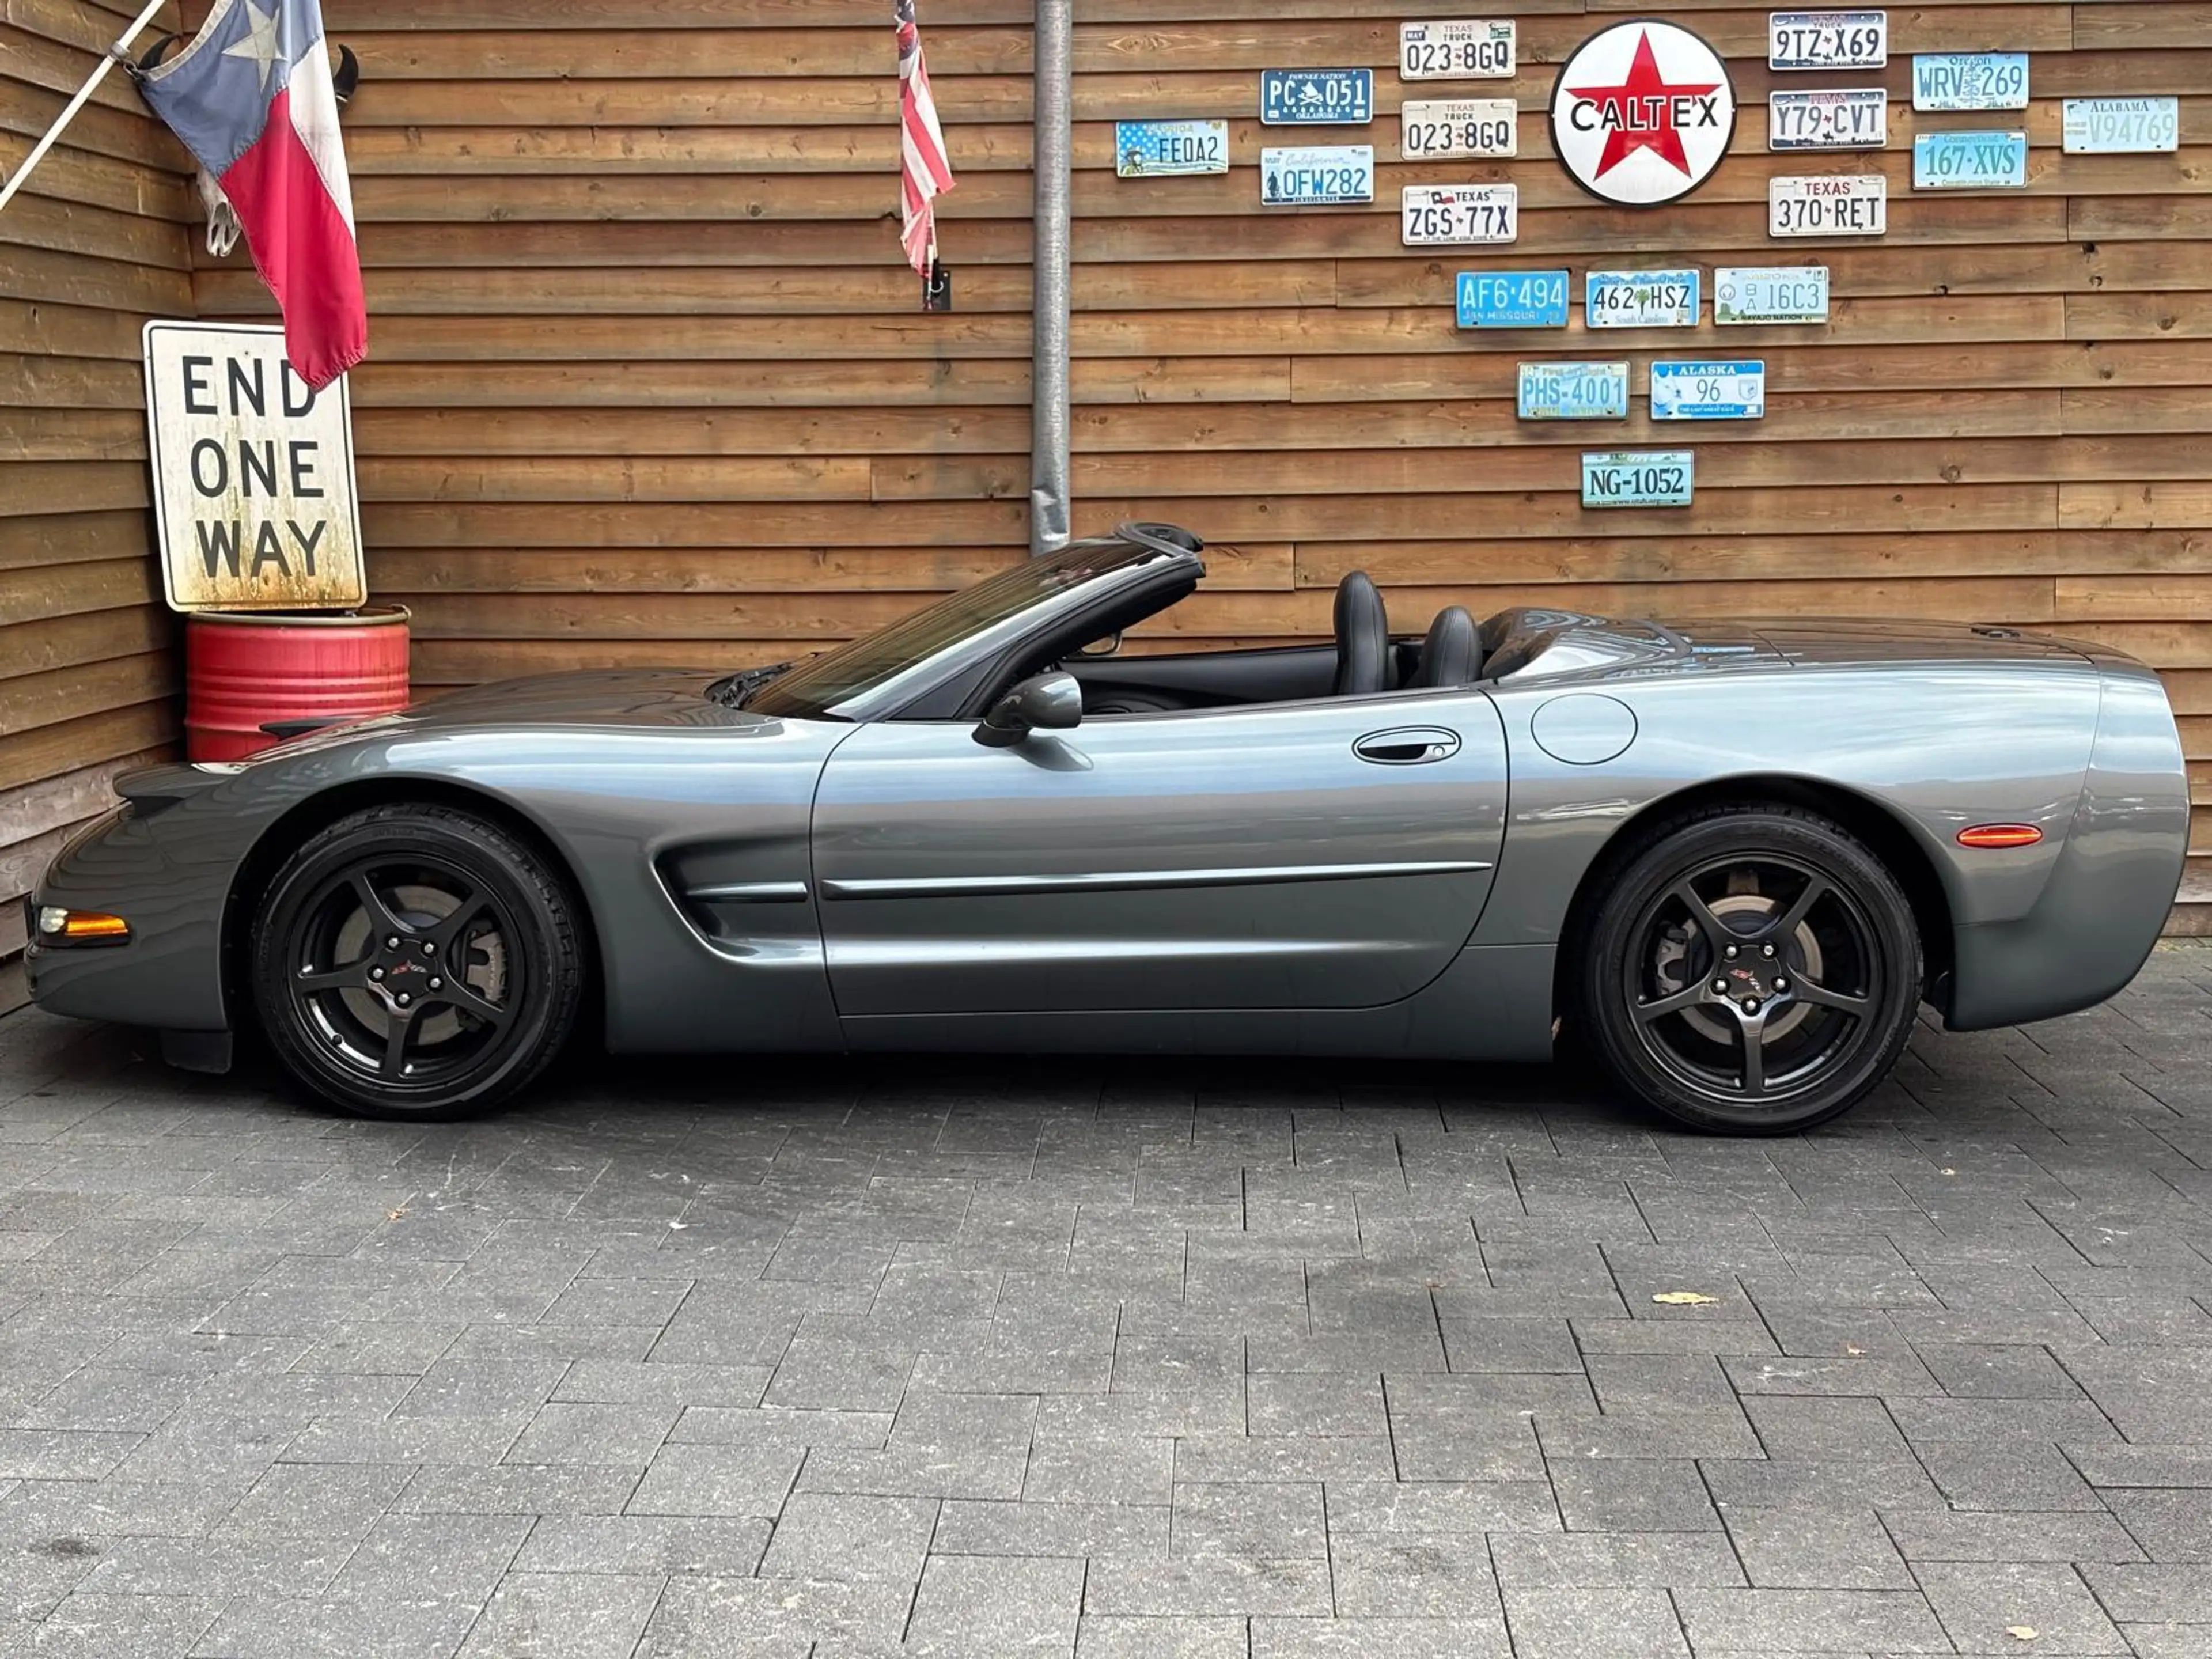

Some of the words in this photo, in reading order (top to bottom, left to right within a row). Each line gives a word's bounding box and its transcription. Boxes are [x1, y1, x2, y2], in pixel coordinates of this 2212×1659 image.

[1949, 56, 1991, 66] Oregon
[1571, 97, 1718, 131] CALTEX
[2090, 101, 2149, 113] ALABAMA
[2089, 113, 2175, 143] V94769
[1455, 192, 1490, 202] TEXAS
[1804, 182, 1851, 195] TEXAS
[1680, 365, 1736, 376] ALASKA
[182, 355, 316, 418] END
[1523, 378, 1622, 405] PHS-4001
[1696, 378, 1721, 402] 96
[191, 438, 324, 498] ONE
[1590, 468, 1684, 495] NG-1052
[196, 520, 327, 577] WAY
